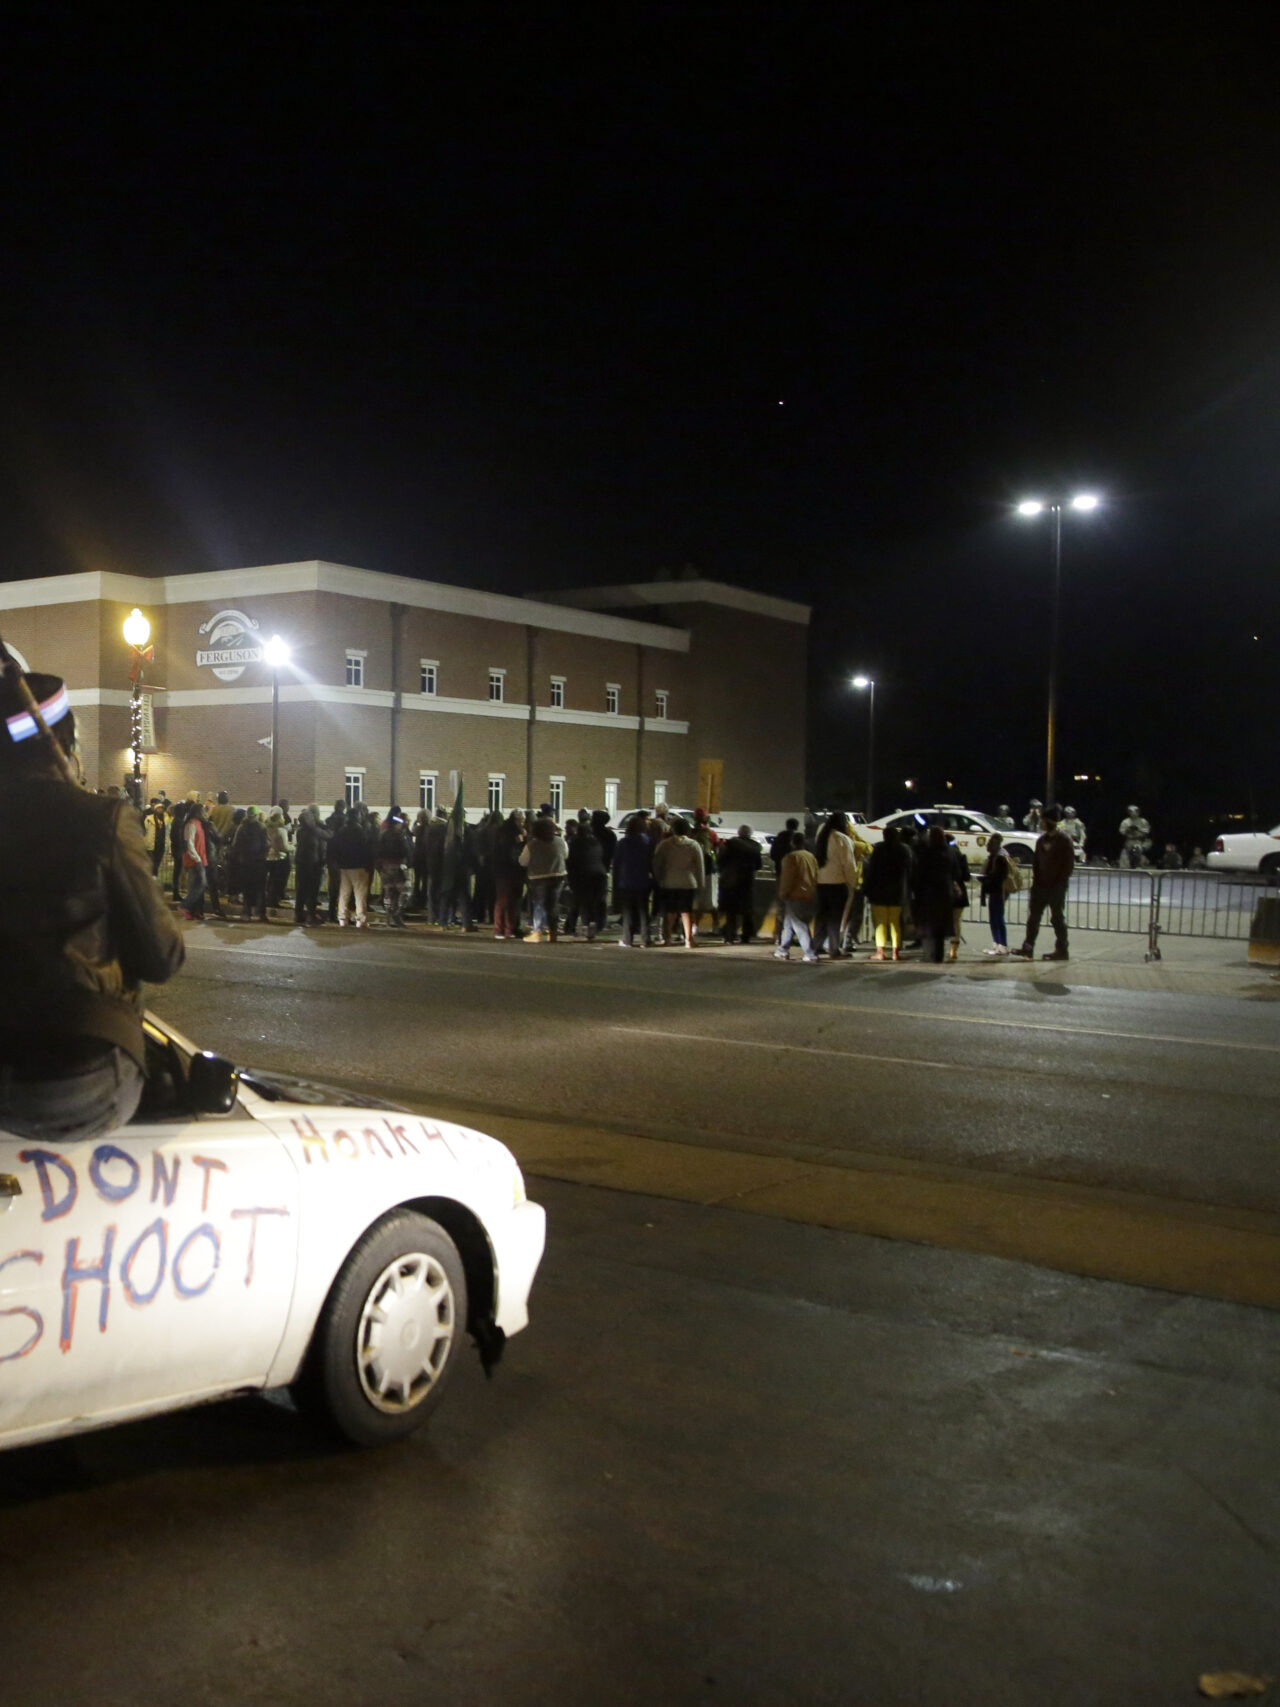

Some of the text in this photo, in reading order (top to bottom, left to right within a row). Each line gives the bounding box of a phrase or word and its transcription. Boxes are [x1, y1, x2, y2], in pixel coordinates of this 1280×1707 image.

[200, 649, 259, 663] FERGUSON
[290, 1113, 420, 1164] Honk
[17, 1145, 229, 1222] DONT
